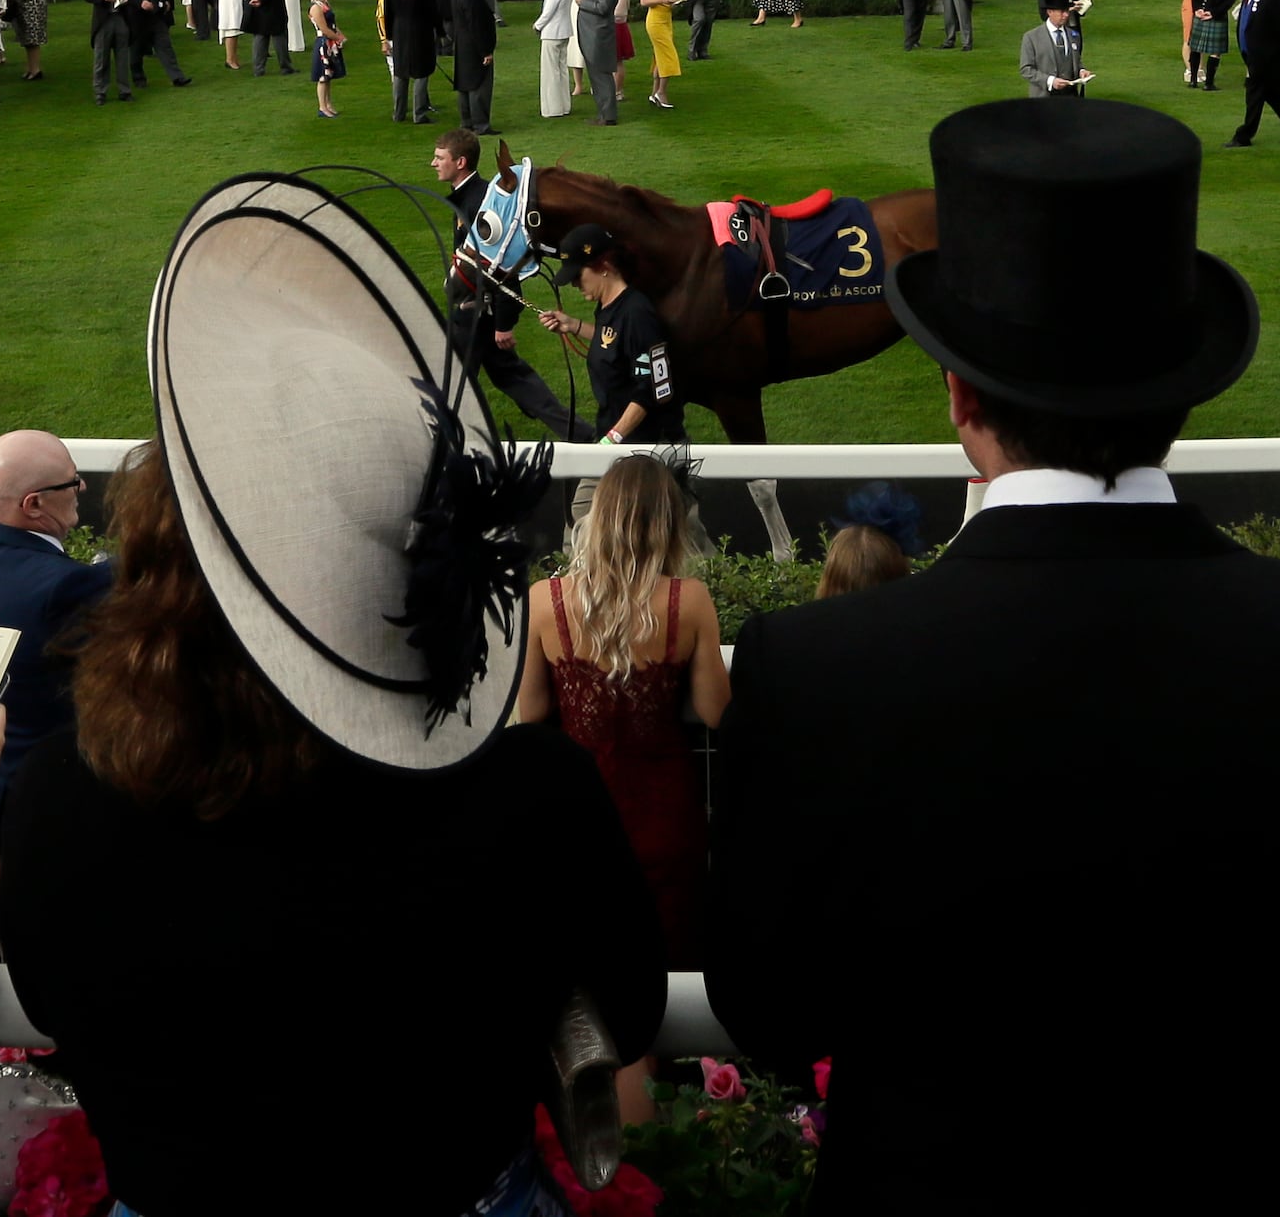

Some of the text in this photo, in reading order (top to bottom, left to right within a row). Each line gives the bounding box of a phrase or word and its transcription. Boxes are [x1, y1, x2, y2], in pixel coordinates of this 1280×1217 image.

[837, 226, 873, 278] 3
[845, 285, 883, 296] ASCOT
[657, 363, 664, 378] 3
